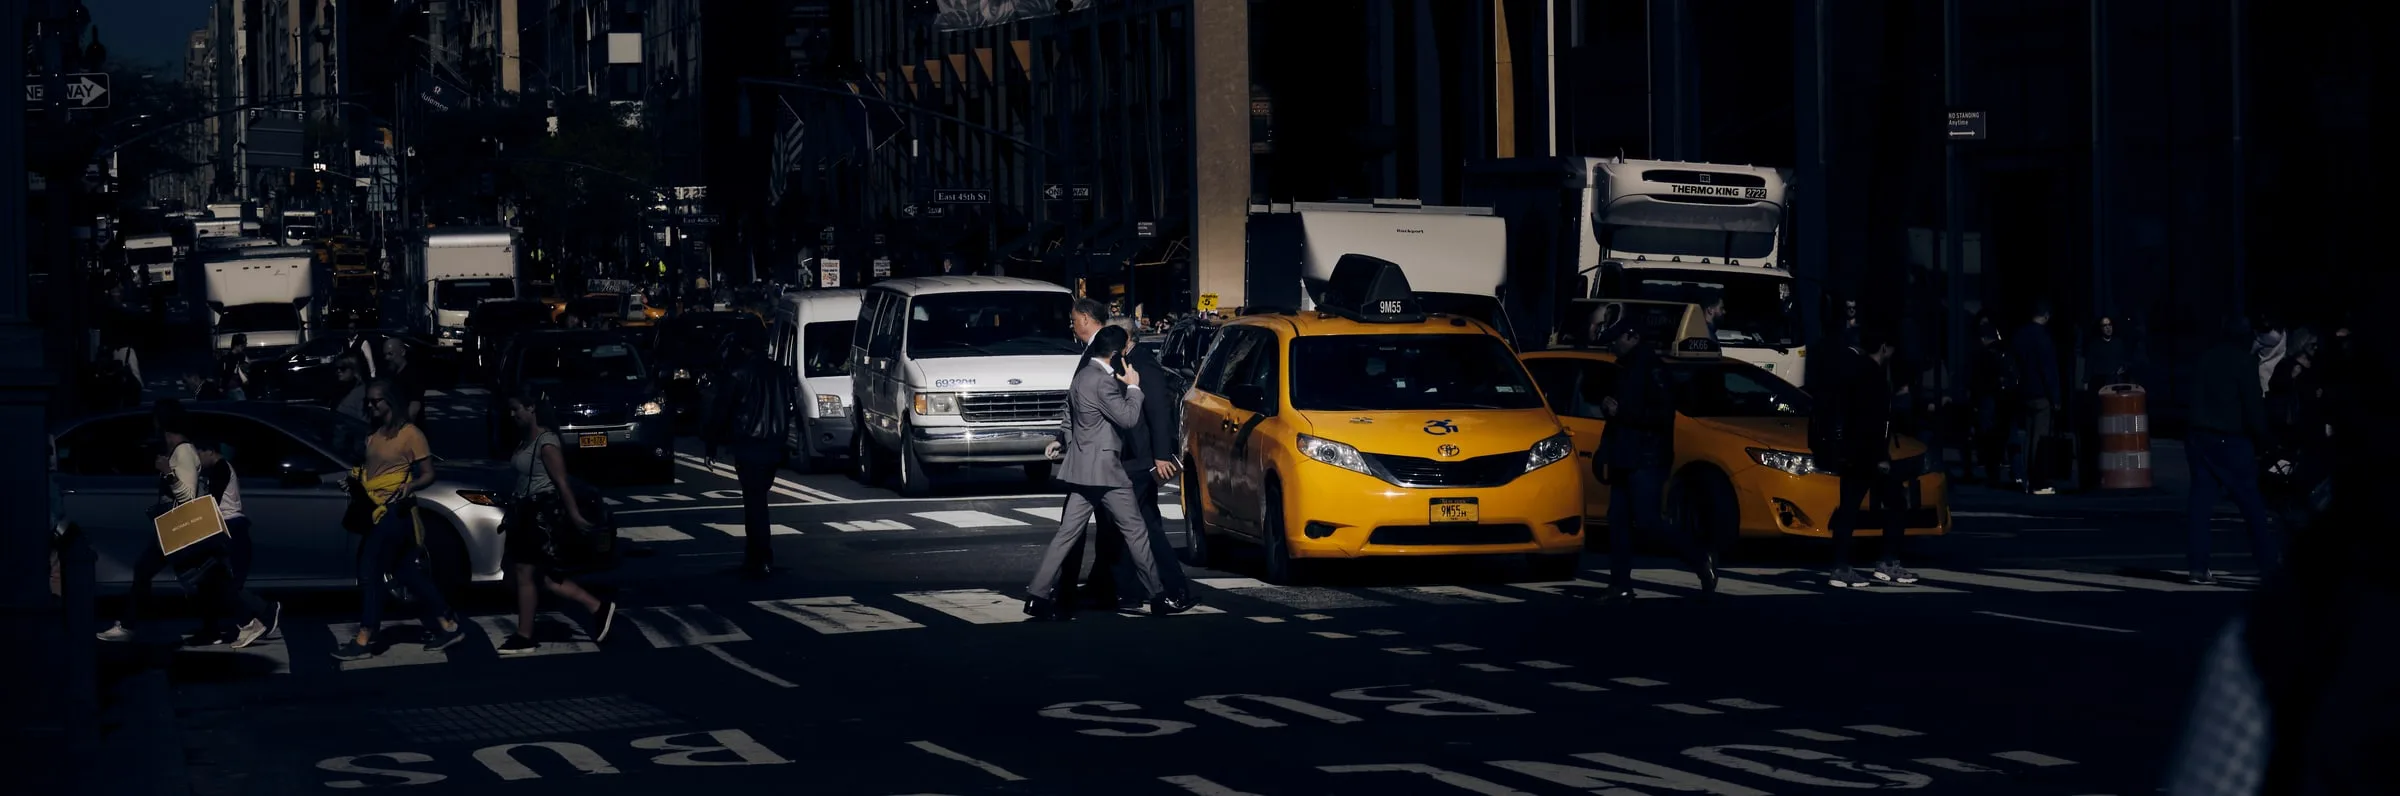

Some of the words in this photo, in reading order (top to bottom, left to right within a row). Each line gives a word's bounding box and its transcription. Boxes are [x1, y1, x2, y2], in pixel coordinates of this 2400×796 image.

[937, 191, 957, 201] East
[957, 191, 977, 201] 45th
[977, 191, 988, 201] St
[1671, 184, 1714, 195] THERMO
[1715, 187, 1739, 196] KING
[1745, 188, 1767, 199] 2722
[1380, 300, 1402, 314] 9M55
[1038, 684, 1538, 738] BUS
[315, 728, 797, 790] BUS
